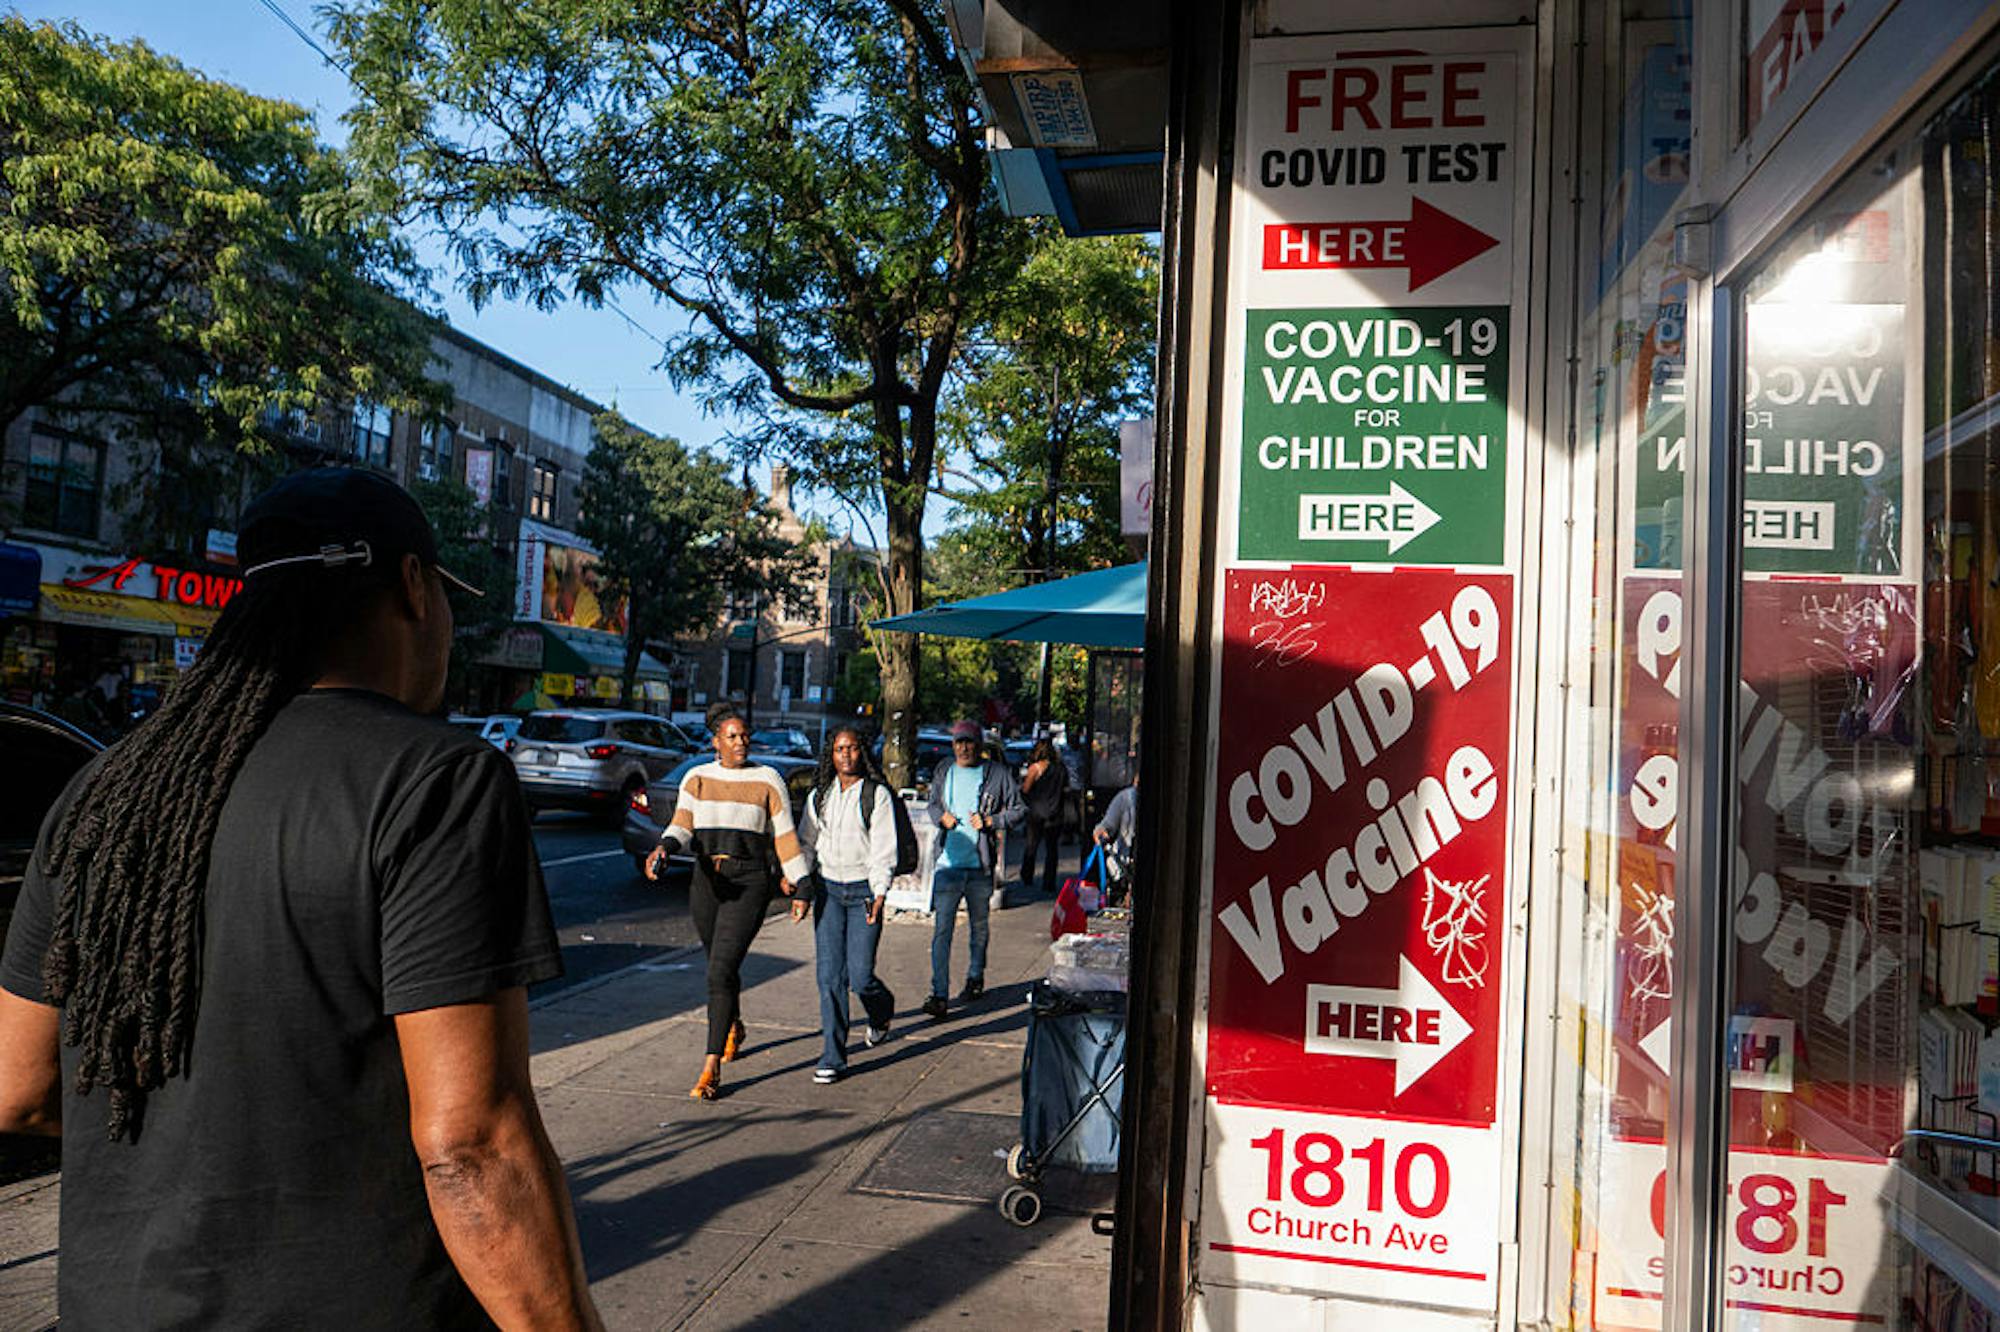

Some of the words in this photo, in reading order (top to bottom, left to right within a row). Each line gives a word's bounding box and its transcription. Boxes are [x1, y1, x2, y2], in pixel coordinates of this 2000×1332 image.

[1285, 62, 1486, 133] FREE
[1261, 147, 1386, 187] COVID
[1402, 143, 1506, 184] TEST
[1279, 227, 1406, 263] HERE
[1264, 318, 1498, 359] COVID-19
[1261, 364, 1487, 404] VACCINE
[1354, 409, 1401, 428] FOR
[1258, 435, 1488, 470] CHILDREN
[1310, 503, 1415, 532] HERE
[63, 555, 145, 589] A
[1229, 585, 1500, 851] COVID-19
[1218, 746, 1498, 985] Vaccine
[1316, 1001, 1440, 1045] HERE
[1250, 1127, 1450, 1219] 1810
[1248, 1207, 1371, 1245] Church
[1384, 1222, 1449, 1254] Ave
